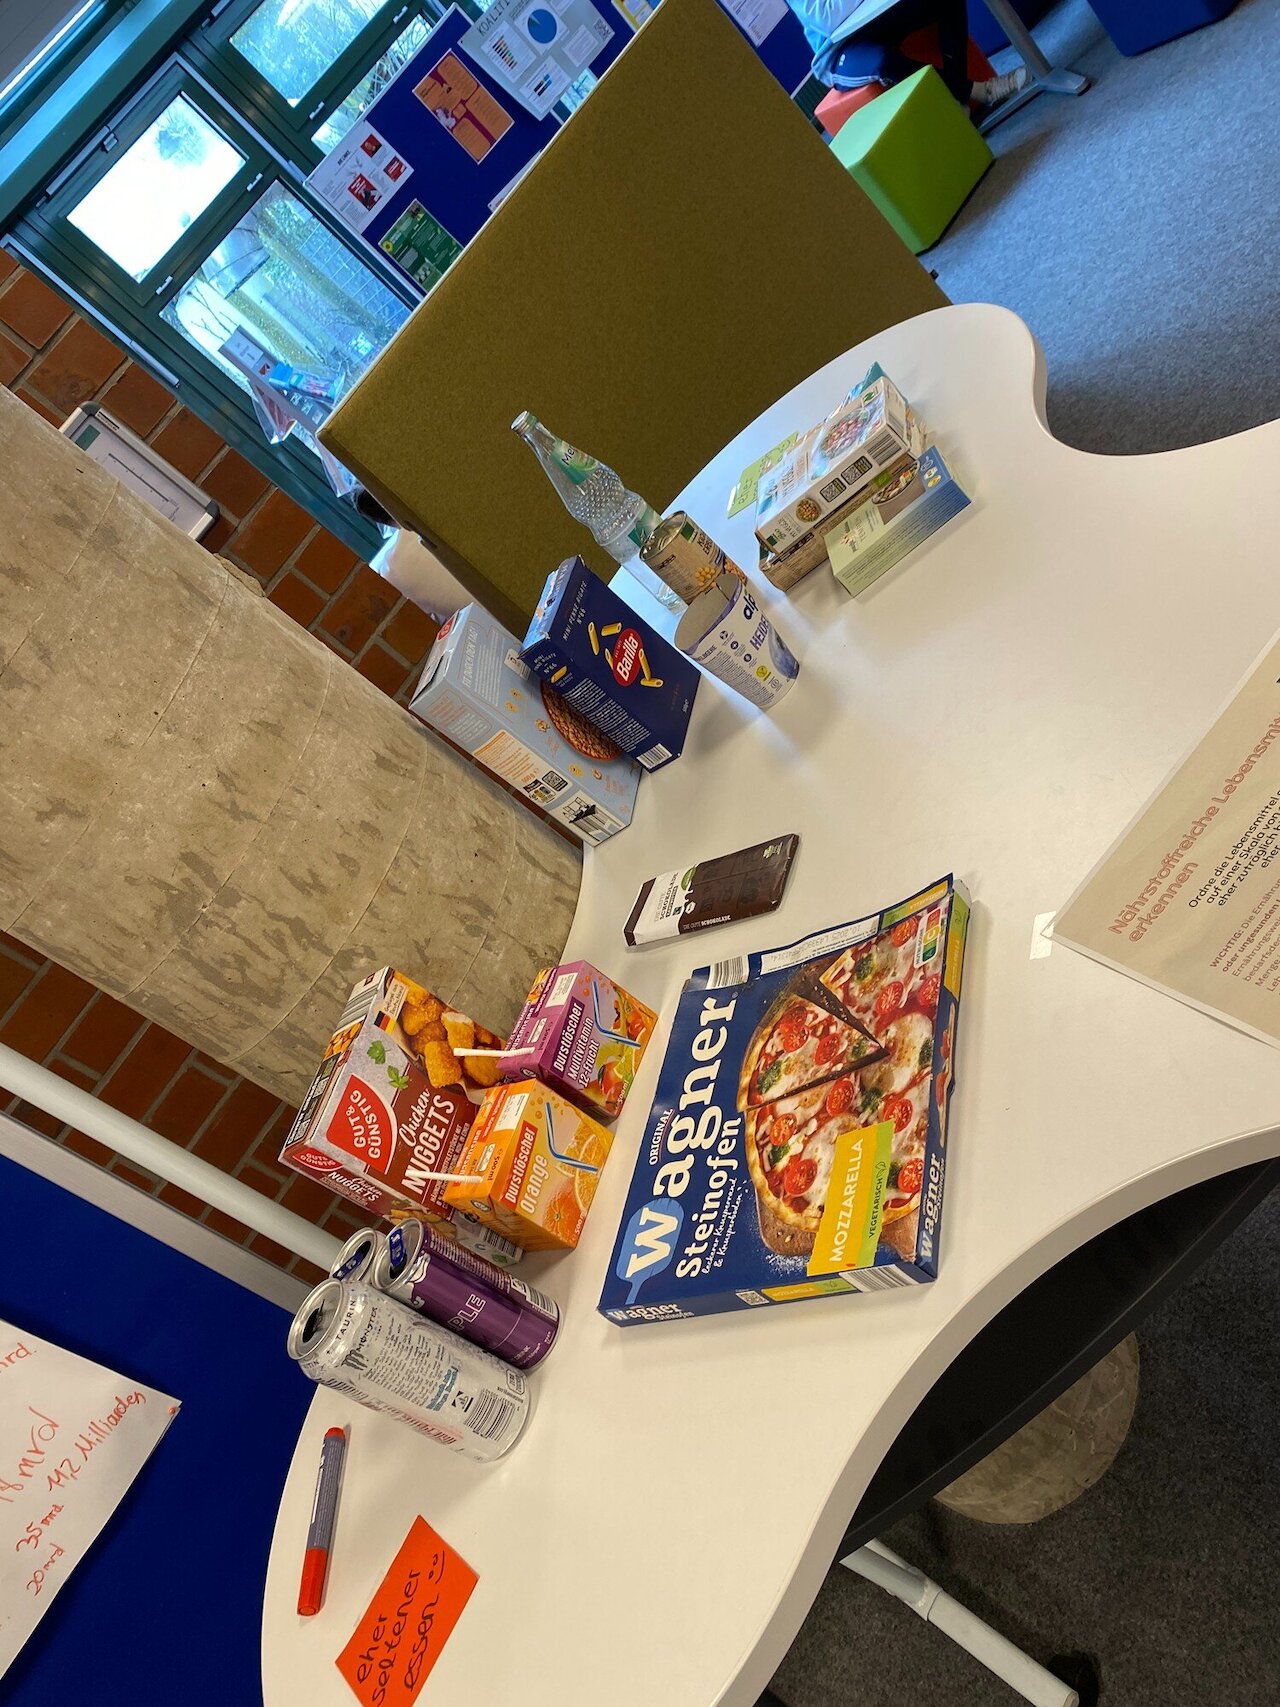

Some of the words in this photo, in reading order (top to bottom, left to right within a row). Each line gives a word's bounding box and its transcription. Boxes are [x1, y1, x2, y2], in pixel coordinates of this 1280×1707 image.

[561, 623, 572, 640] MINI
[615, 635, 639, 681] Barilla
[1108, 804, 1220, 935] Nährstoffreiche
[1187, 875, 1216, 909] Ordne
[1212, 858, 1229, 877] die
[1224, 794, 1279, 861] Lebensmittel
[1204, 885, 1222, 904] auf
[1218, 859, 1242, 887] einer
[1238, 829, 1265, 860] Skala
[1262, 811, 1280, 832] von
[1215, 881, 1238, 907] eher
[1234, 829, 1279, 883] zuträglich
[1129, 861, 1198, 942] erkennen
[1209, 927, 1244, 969] WICHTIG:
[1240, 913, 1255, 930] Die
[1221, 951, 1240, 973] oder
[1237, 901, 1280, 954] ungesunden
[552, 1001, 584, 1073] Durstlöscher
[566, 1016, 594, 1080] Multivitamin
[577, 1038, 600, 1088] 12-Frucht
[349, 1088, 381, 1157] GÜNSTIG
[399, 1087, 431, 1146] Chicken
[401, 1094, 454, 1194] NUGGETS
[649, 1109, 673, 1166] ORIGINAL
[505, 1126, 536, 1205] Durstlöscher
[519, 1153, 549, 1215] Orange
[676, 1118, 742, 1279] Steinofen
[711, 1176, 739, 1237] Knusperrand
[716, 1193, 745, 1257] Knusperboden
[829, 1138, 865, 1263] MOZZARELLA
[868, 1177, 883, 1240] VEGETARISCH
[335, 1299, 356, 1341] TAURIN
[357, 1614, 388, 1684] eher
